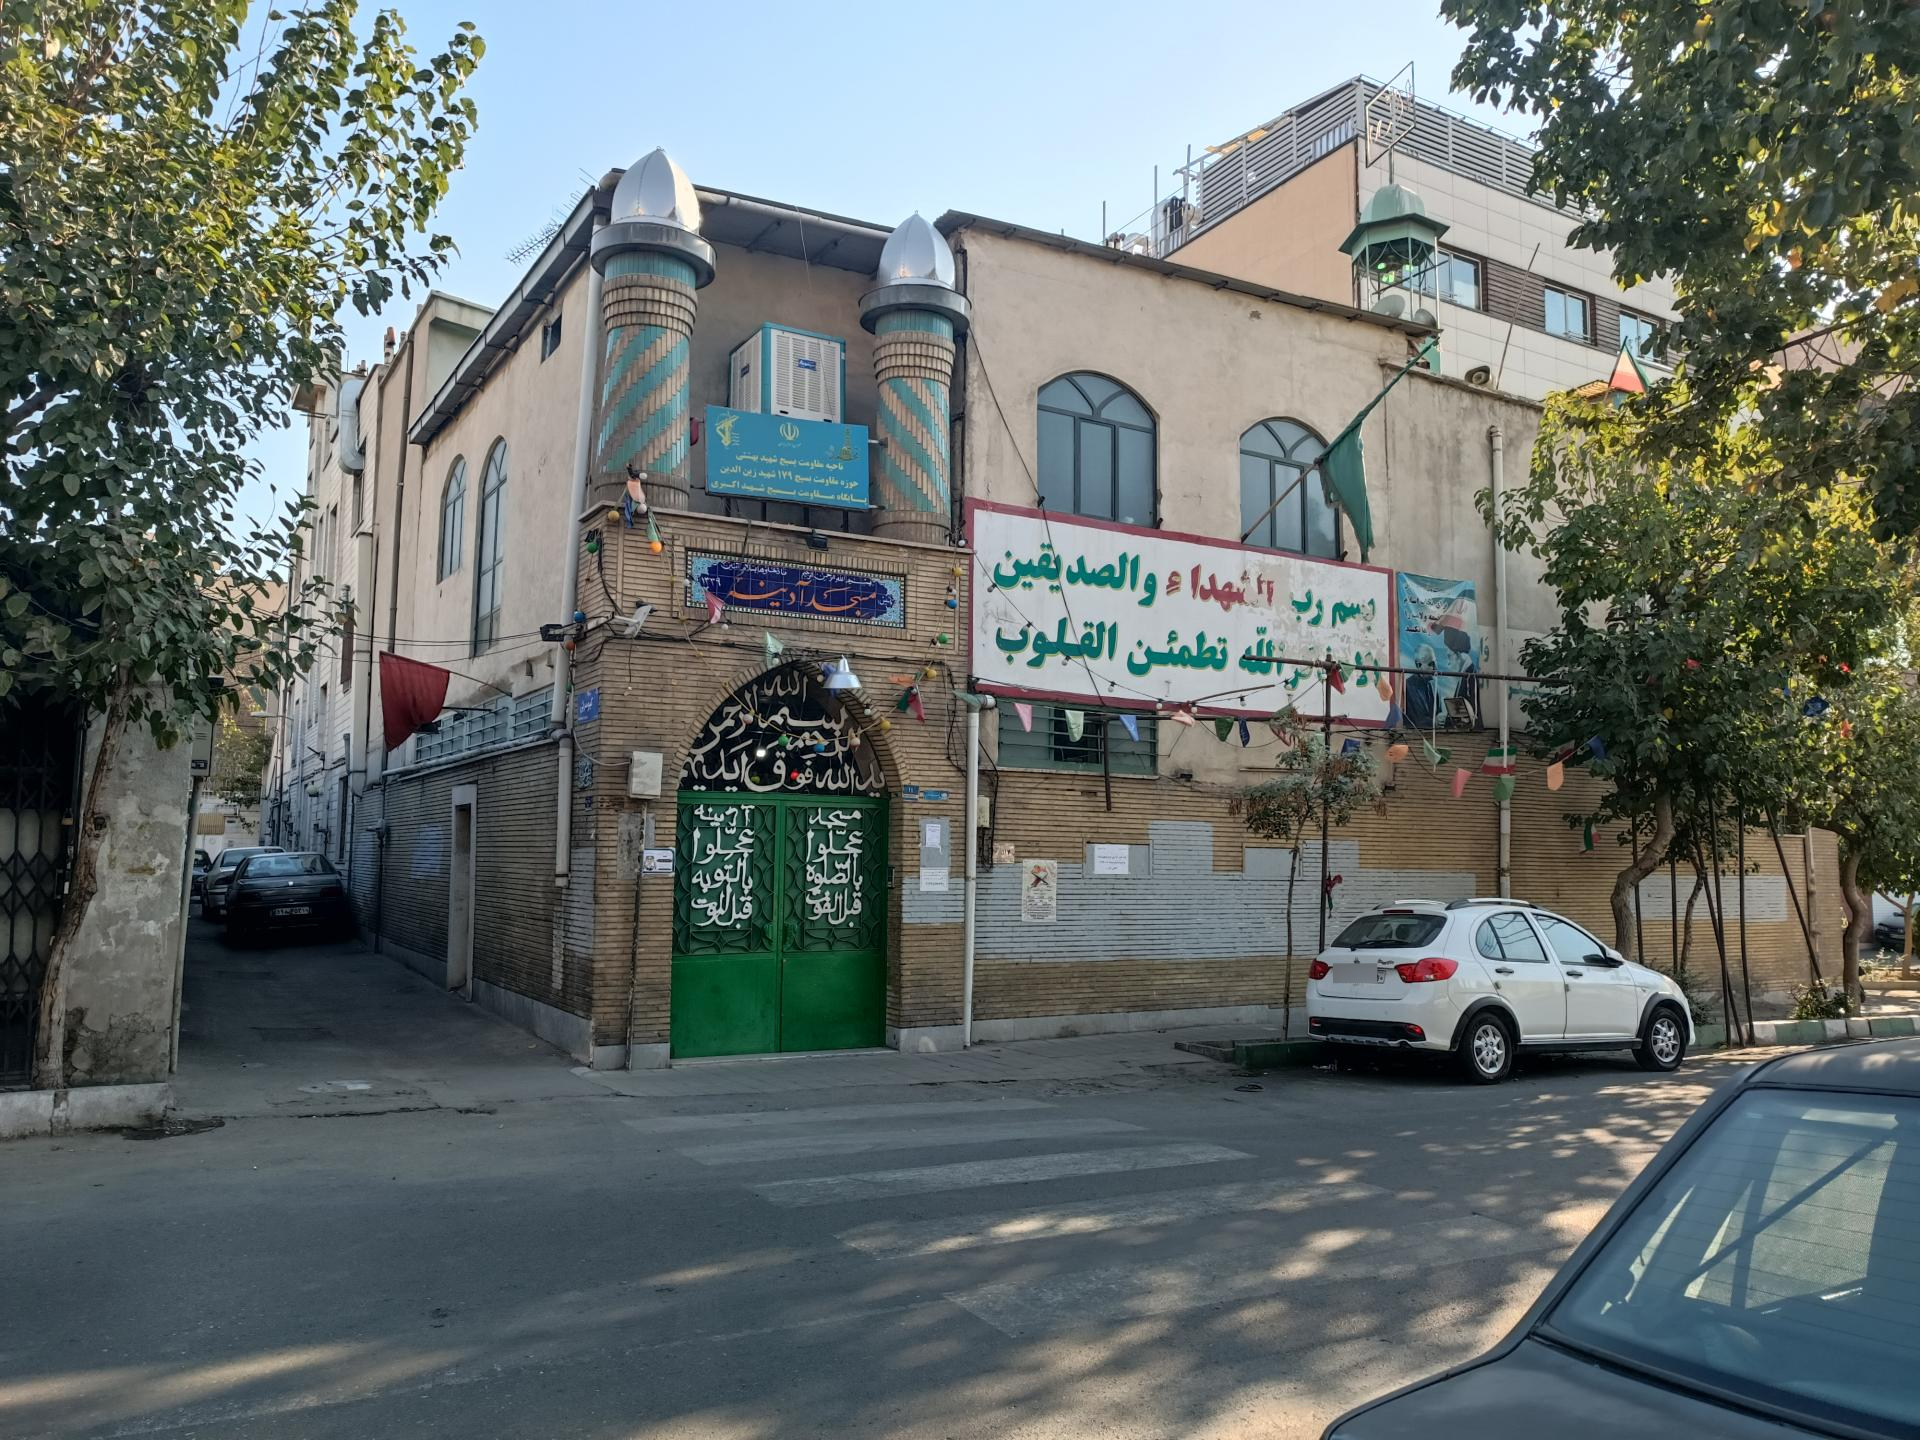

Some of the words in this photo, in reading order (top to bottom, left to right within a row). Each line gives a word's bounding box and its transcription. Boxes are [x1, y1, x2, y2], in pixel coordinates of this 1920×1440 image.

[735, 451, 759, 461] بهشتی
[760, 454, 778, 463] شهید
[779, 456, 796, 467] بسیج
[719, 465, 741, 475] الدین
[799, 459, 824, 470] مقاومت
[825, 462, 844, 471] ناحیه
[758, 469, 776, 479] شهید
[794, 474, 812, 483] بسیج
[710, 479, 740, 489] اکبری
[813, 475, 839, 487] مقاومت
[840, 479, 859, 489] حوزه
[741, 483, 766, 492] شهید
[767, 485, 796, 495] بسیج
[797, 488, 835, 500] مقاومت
[836, 491, 868, 506] پایگاه
[725, 576, 812, 608] آدینه
[804, 586, 877, 618] مسجد
[1289, 588, 1324, 628] رب
[995, 616, 1118, 668] القلوب
[1127, 630, 1228, 677] تطمئن
[763, 670, 809, 703] الله
[744, 750, 815, 793] فوق
[815, 762, 856, 795] الله
[693, 803, 755, 827] آدینه
[808, 807, 863, 829] مسجد
